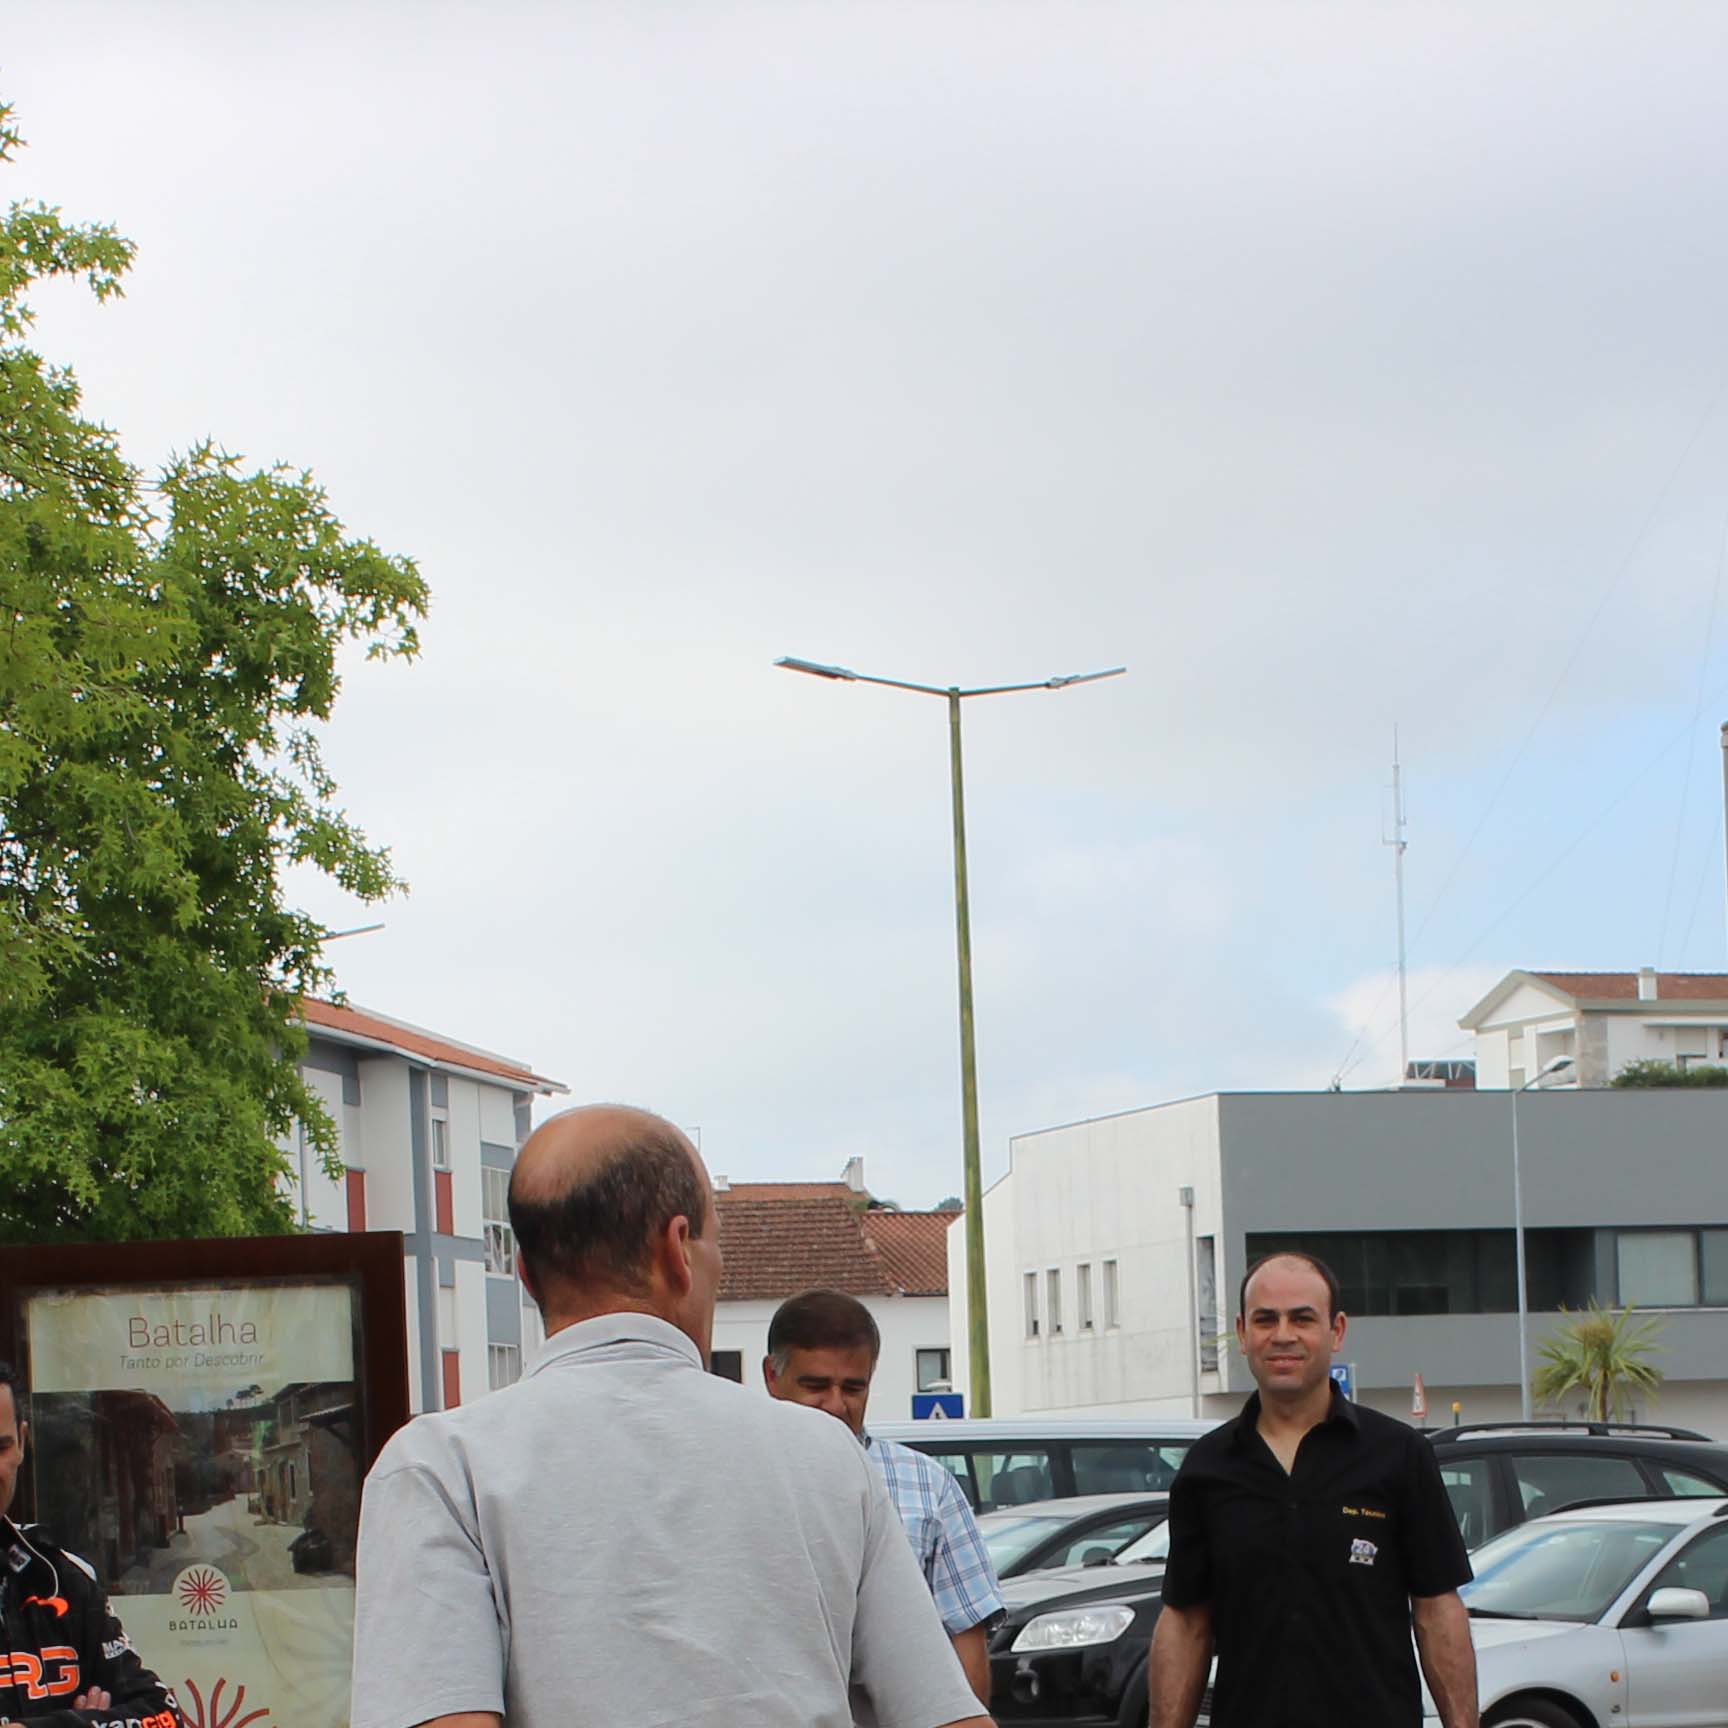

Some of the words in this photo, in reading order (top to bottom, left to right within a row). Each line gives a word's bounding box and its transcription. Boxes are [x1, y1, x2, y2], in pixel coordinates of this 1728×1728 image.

[128, 1314, 258, 1349] Batalha
[120, 1357, 161, 1371] Tanto
[165, 1358, 191, 1373] por
[194, 1352, 264, 1368] Descobrir
